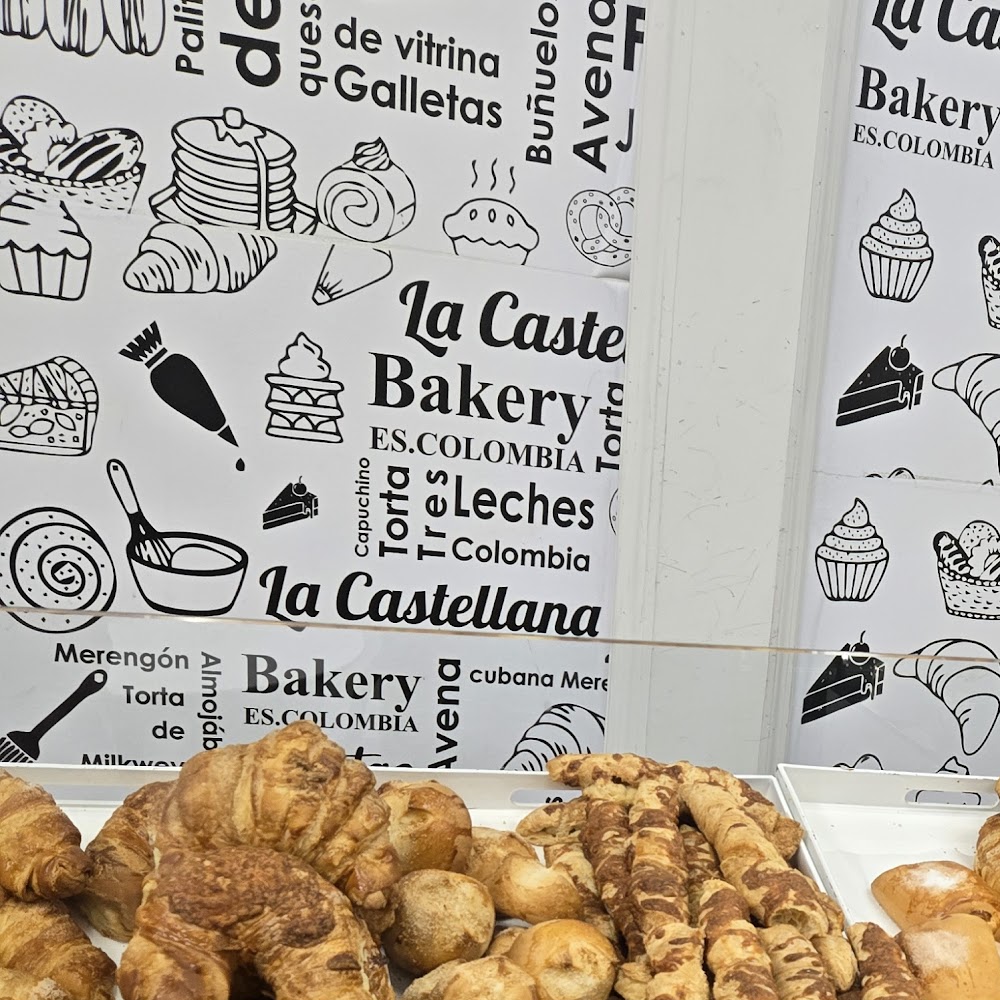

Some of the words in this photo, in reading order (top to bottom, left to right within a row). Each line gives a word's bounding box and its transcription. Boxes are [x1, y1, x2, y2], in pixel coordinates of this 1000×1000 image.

[174, 0, 204, 75] Pali
[300, 3, 328, 96] ques
[335, 17, 382, 53] de
[395, 30, 499, 78] vitrina
[872, 0, 922, 51] La
[335, 65, 502, 128] Galletas
[526, 2, 558, 165] Buñuelo
[573, 0, 615, 173] Avena
[850, 121, 995, 171] ES.COLOMBIA
[399, 281, 463, 357] La
[480, 291, 626, 364] Caste
[368, 352, 592, 444] Bakery
[596, 382, 623, 472] Torta
[367, 425, 586, 474] ES.COLOMBIA
[355, 458, 372, 557] Capuchino
[379, 466, 409, 557] Torta
[418, 470, 448, 560] Tres
[455, 475, 594, 530] Leches
[452, 537, 589, 571] Colombia
[257, 564, 322, 633] La
[335, 570, 603, 639] Castellana
[55, 643, 188, 672] Merengón
[240, 653, 425, 712] Bakery
[470, 667, 553, 687] cubana
[559, 670, 608, 692] Mere
[123, 686, 184, 706] Torta
[152, 721, 184, 740] de
[197, 651, 225, 750] Almojáb
